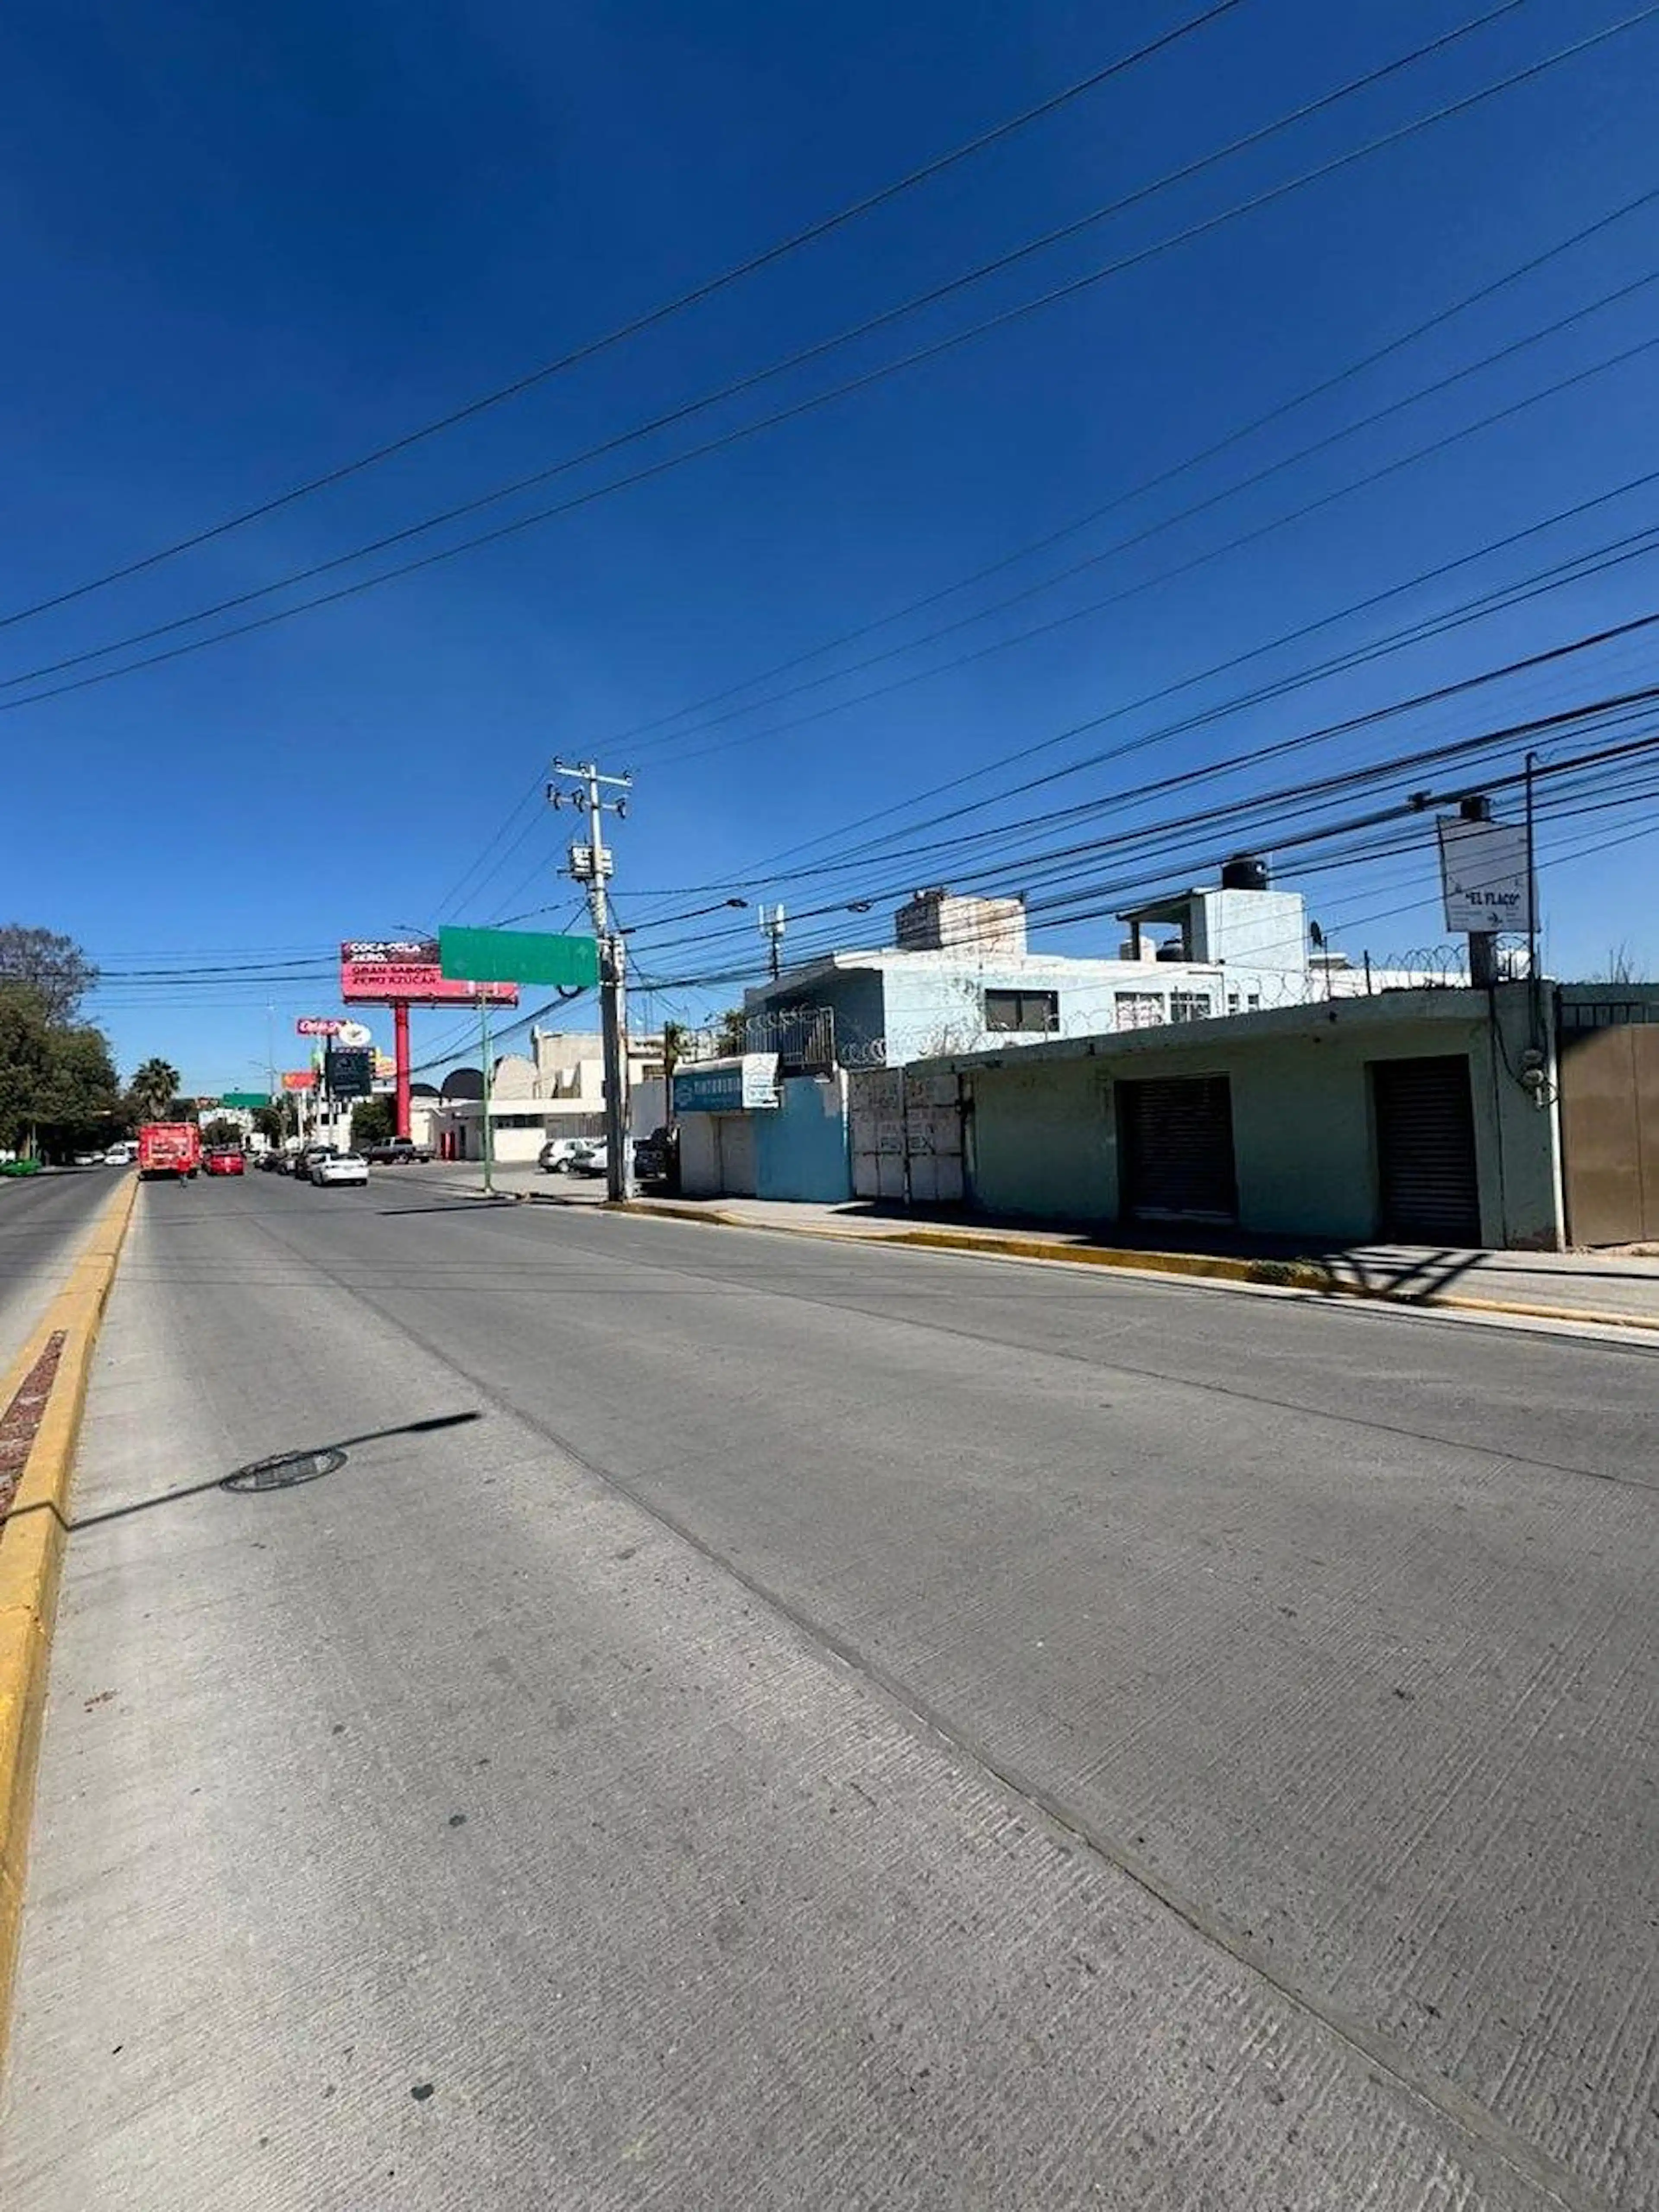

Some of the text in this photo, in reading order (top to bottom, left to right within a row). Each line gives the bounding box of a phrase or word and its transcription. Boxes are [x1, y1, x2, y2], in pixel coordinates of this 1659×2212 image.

[350, 942, 421, 953] COCA-COLA
[352, 966, 387, 974] GRAN
[352, 976, 385, 985] ZERO
